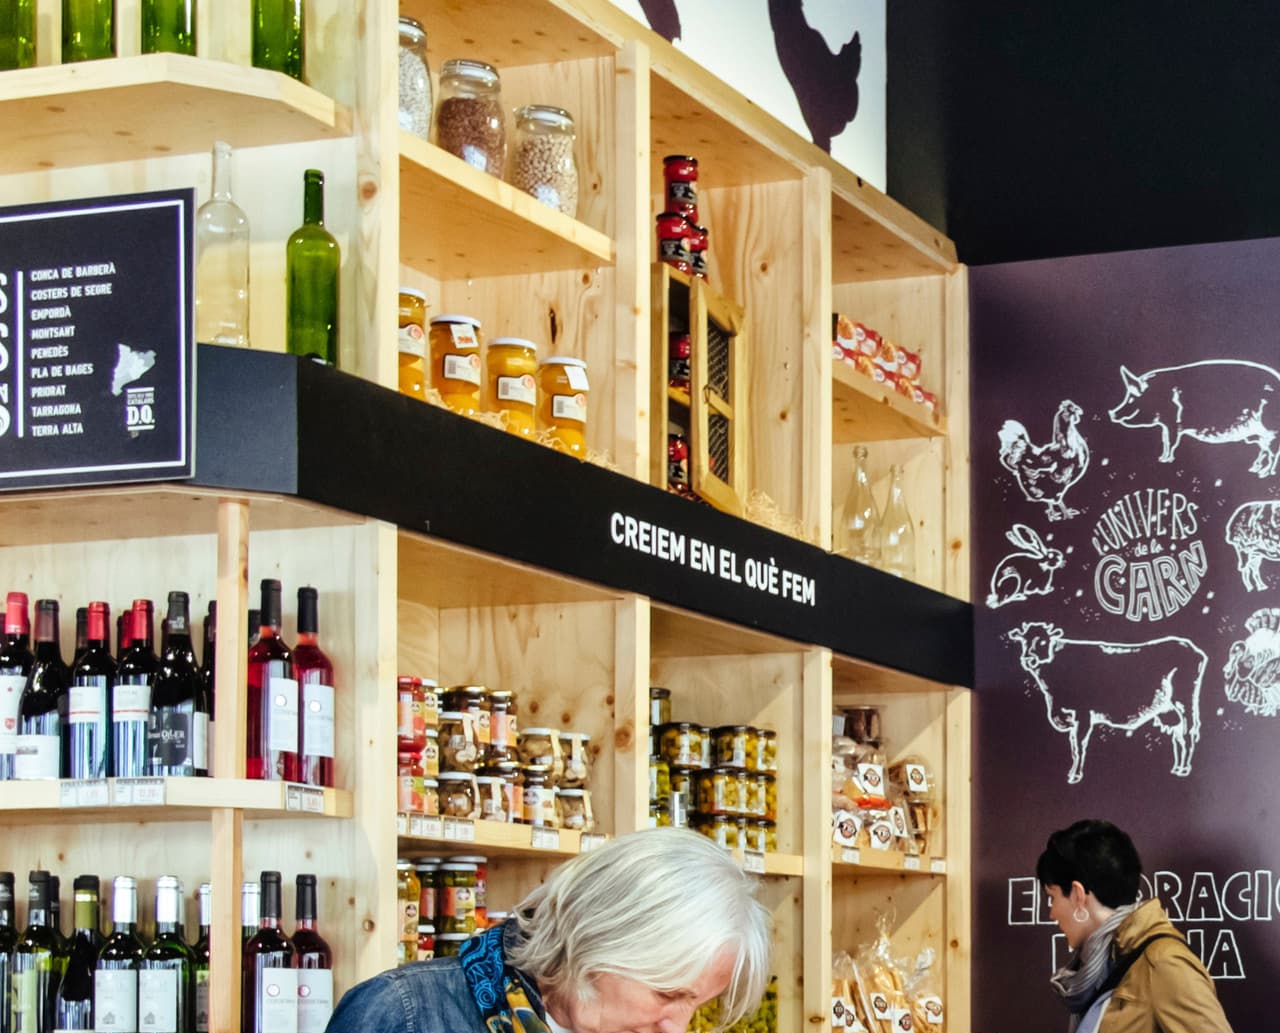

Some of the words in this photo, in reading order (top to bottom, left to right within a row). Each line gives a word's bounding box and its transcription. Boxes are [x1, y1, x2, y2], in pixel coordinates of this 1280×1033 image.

[61, 267, 73, 279] DE
[31, 287, 68, 301] COSTERS
[70, 286, 82, 297] DE
[31, 326, 75, 340] MONTSANT
[31, 367, 48, 378] PLA
[51, 366, 63, 377] DE
[31, 385, 66, 398] PRIORAT
[31, 403, 81, 417] TARRAGONA
[127, 405, 155, 425] D.O.
[31, 424, 59, 436] TERRA
[62, 422, 83, 434] ALTA
[610, 512, 686, 565] CREIEM
[690, 538, 715, 575] EN
[719, 548, 742, 583] EL
[745, 557, 779, 596] QUÈ
[782, 570, 816, 606] FEM
[1095, 540, 1208, 622] CARN
